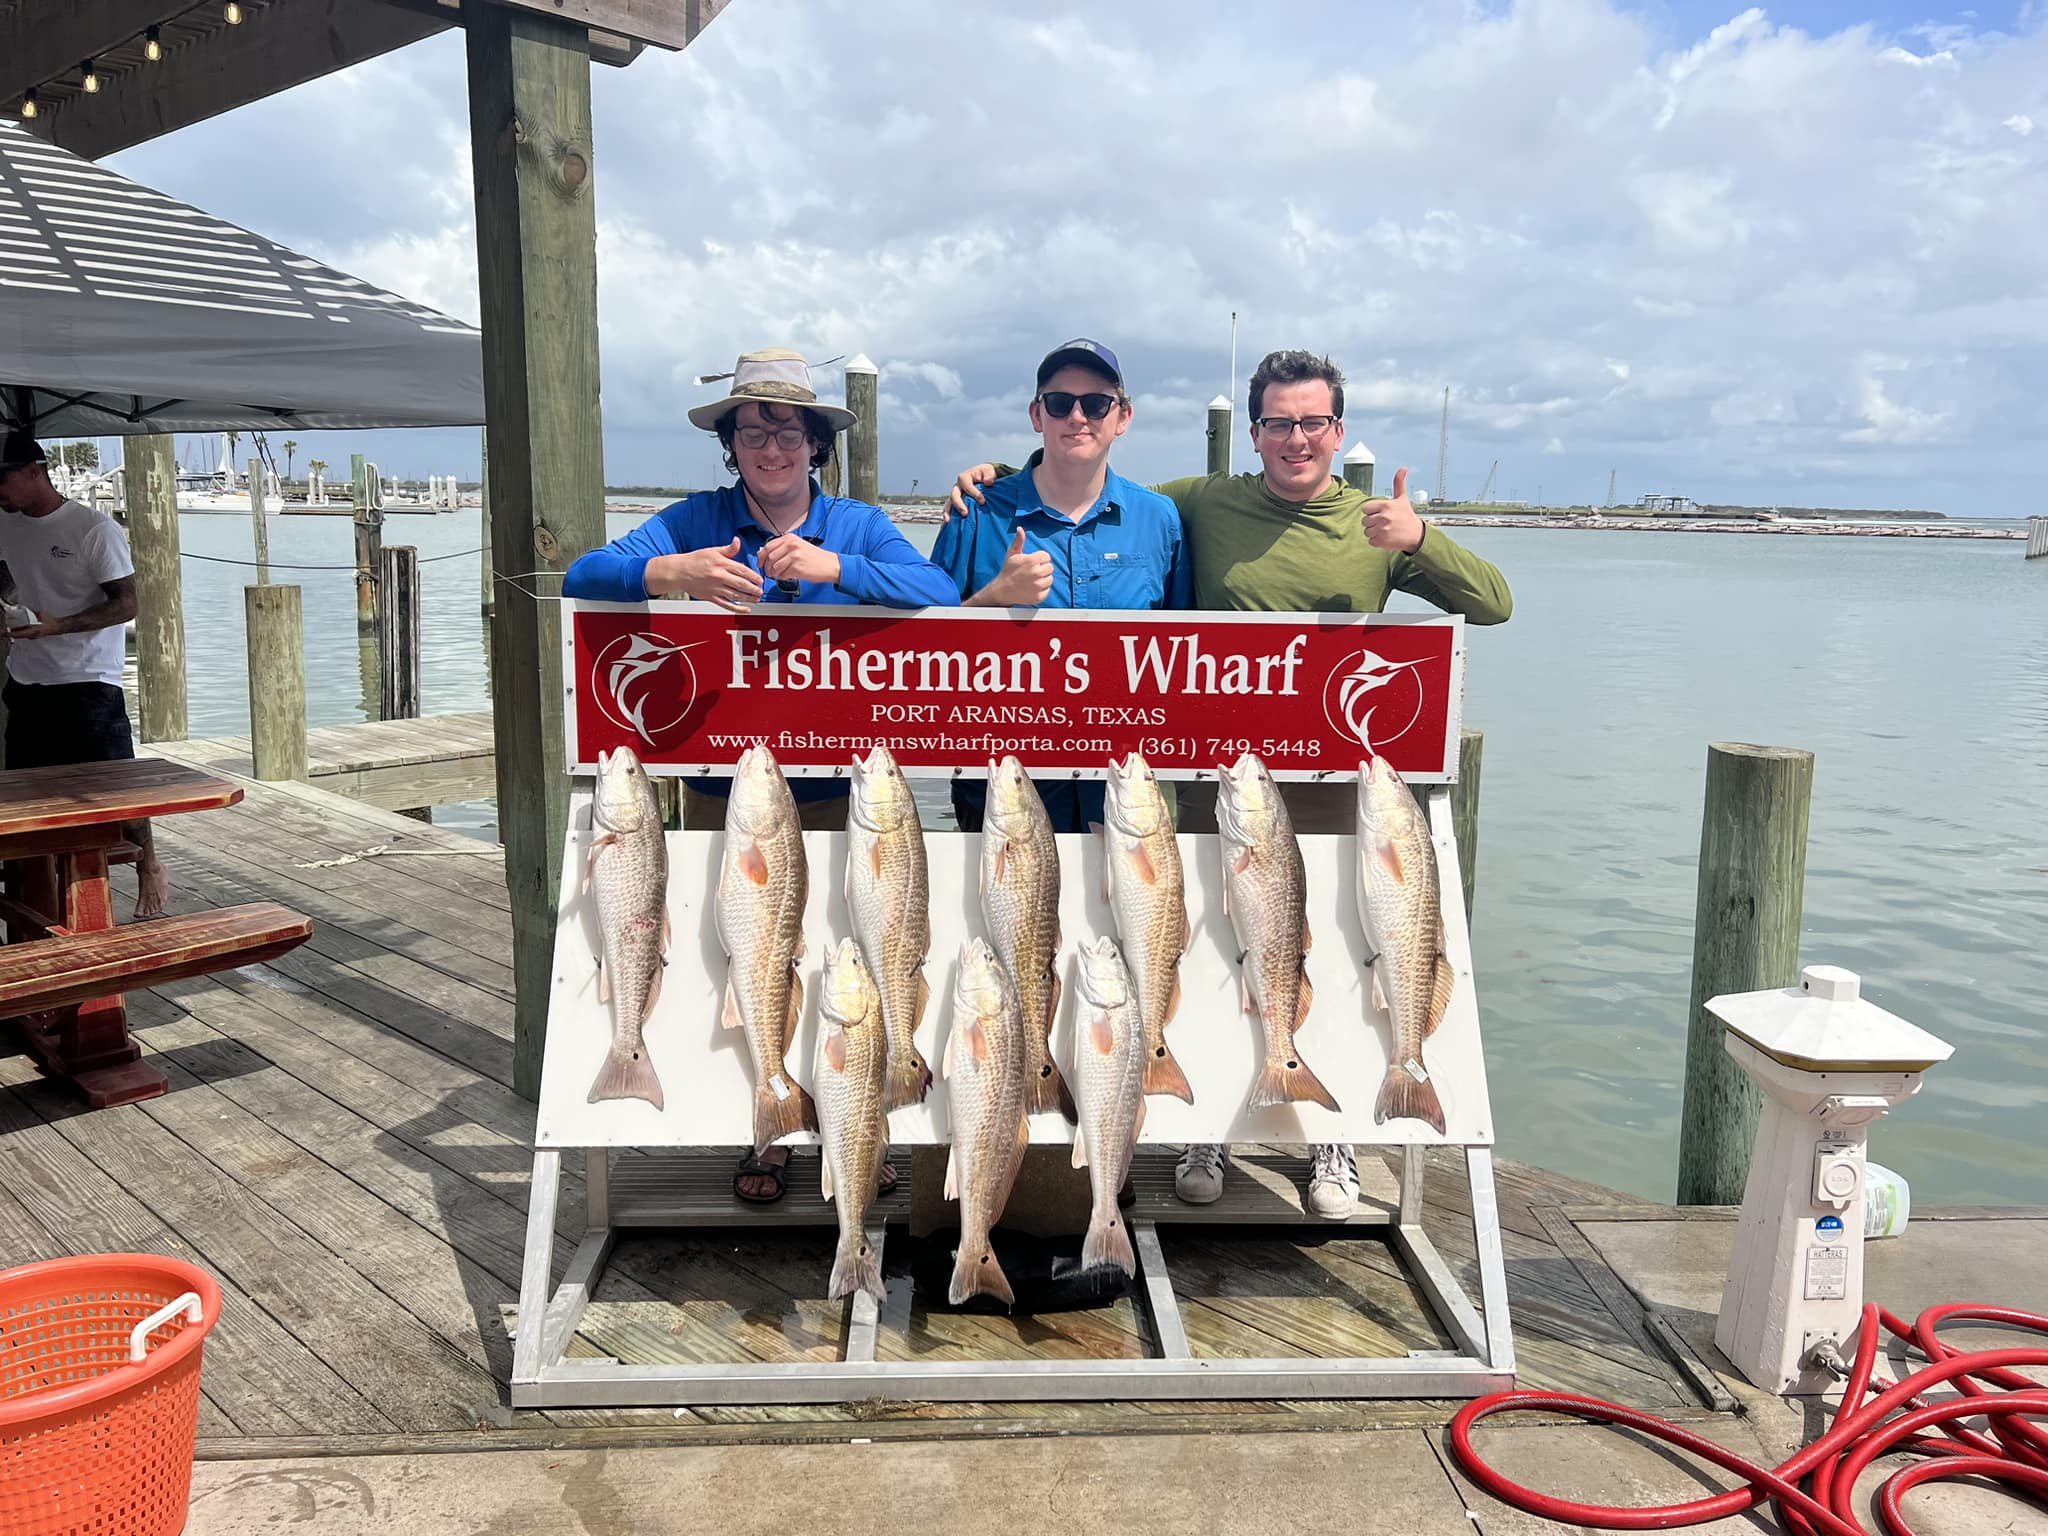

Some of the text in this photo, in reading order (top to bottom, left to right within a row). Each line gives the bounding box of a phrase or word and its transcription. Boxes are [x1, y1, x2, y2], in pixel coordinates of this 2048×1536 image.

[725, 629, 1307, 696] Fisherman's Wharf
[871, 704, 1166, 727] PORT ARANSAS, TEXAS
[707, 731, 1321, 759] www.fishermanswharfporta.com (361) 749-5448
